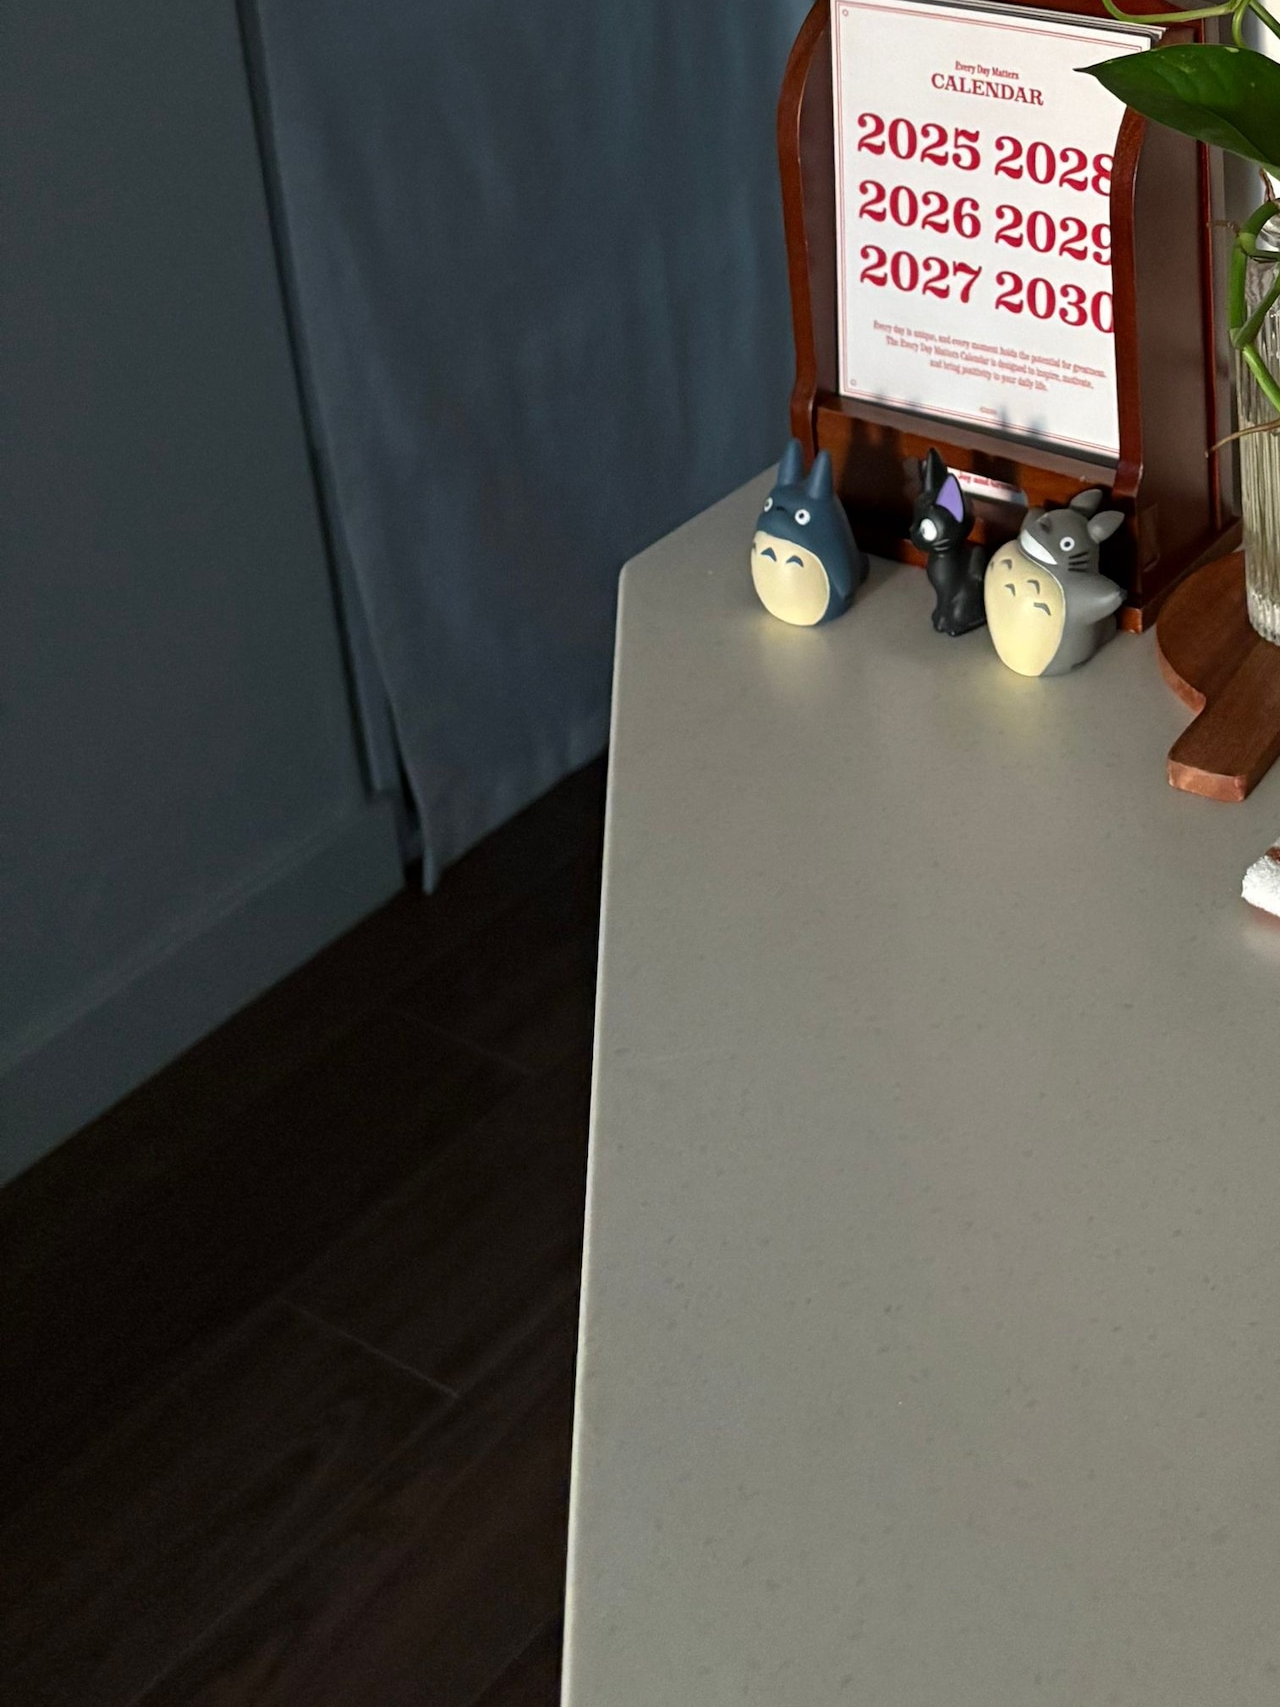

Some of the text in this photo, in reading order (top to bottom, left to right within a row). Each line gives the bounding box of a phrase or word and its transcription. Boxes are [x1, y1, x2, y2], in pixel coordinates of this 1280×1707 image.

[931, 72, 1044, 106] CALENDAR
[955, 60, 1019, 80] Every Day Matters
[857, 112, 1115, 197] 2025 2028
[858, 179, 1111, 266] 2026 2029
[860, 244, 1115, 334] 2027 2030
